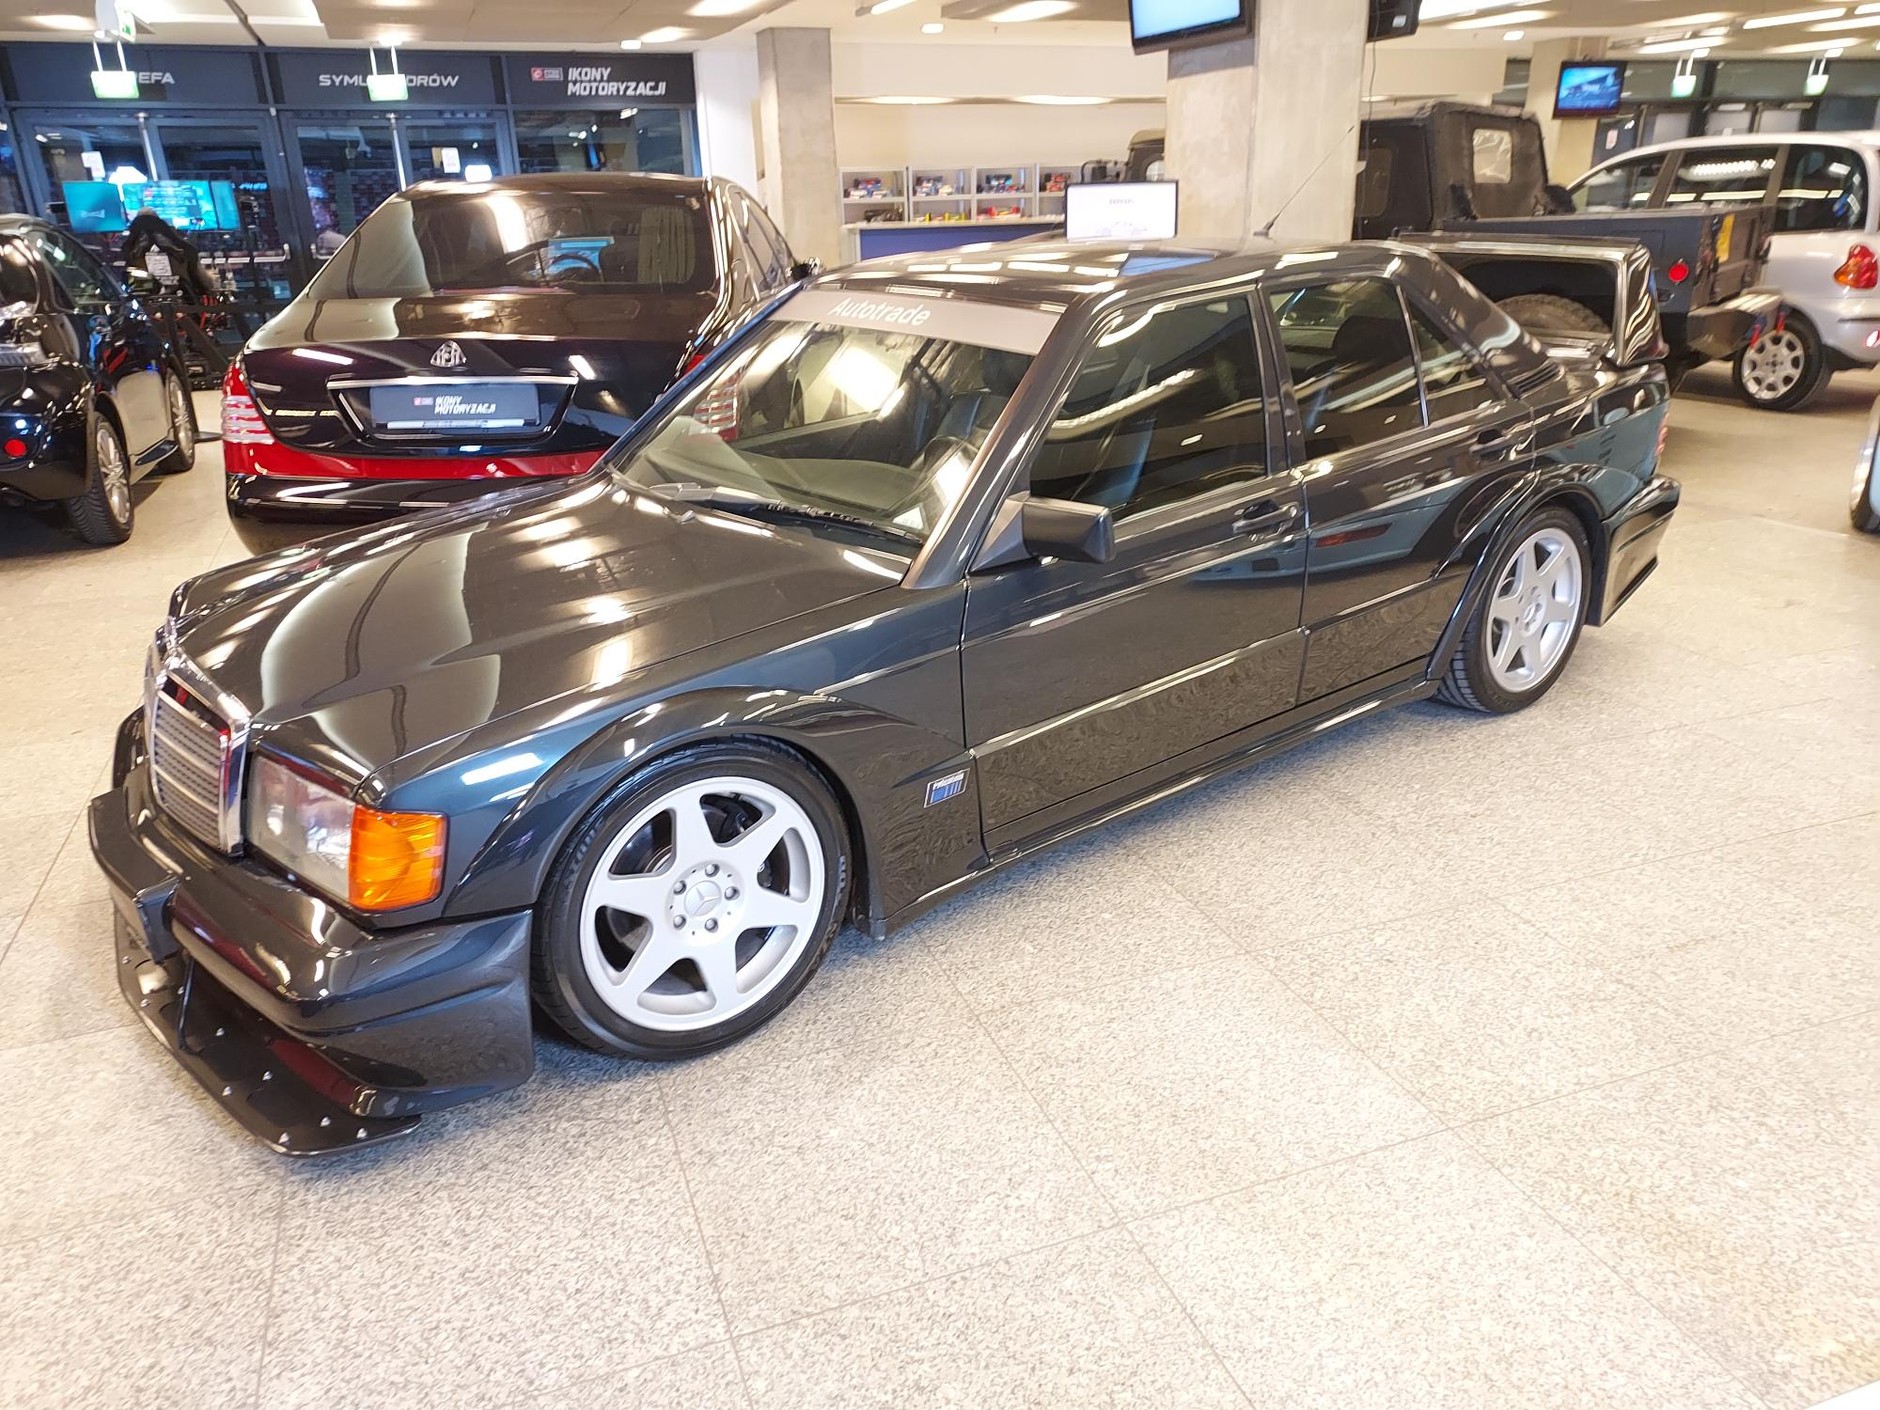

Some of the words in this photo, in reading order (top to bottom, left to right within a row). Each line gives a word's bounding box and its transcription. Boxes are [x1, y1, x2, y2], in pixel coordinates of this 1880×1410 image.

[568, 67, 612, 81] IKONY
[567, 81, 667, 96] MOTORYZACJI
[827, 297, 931, 326] Autotrade
